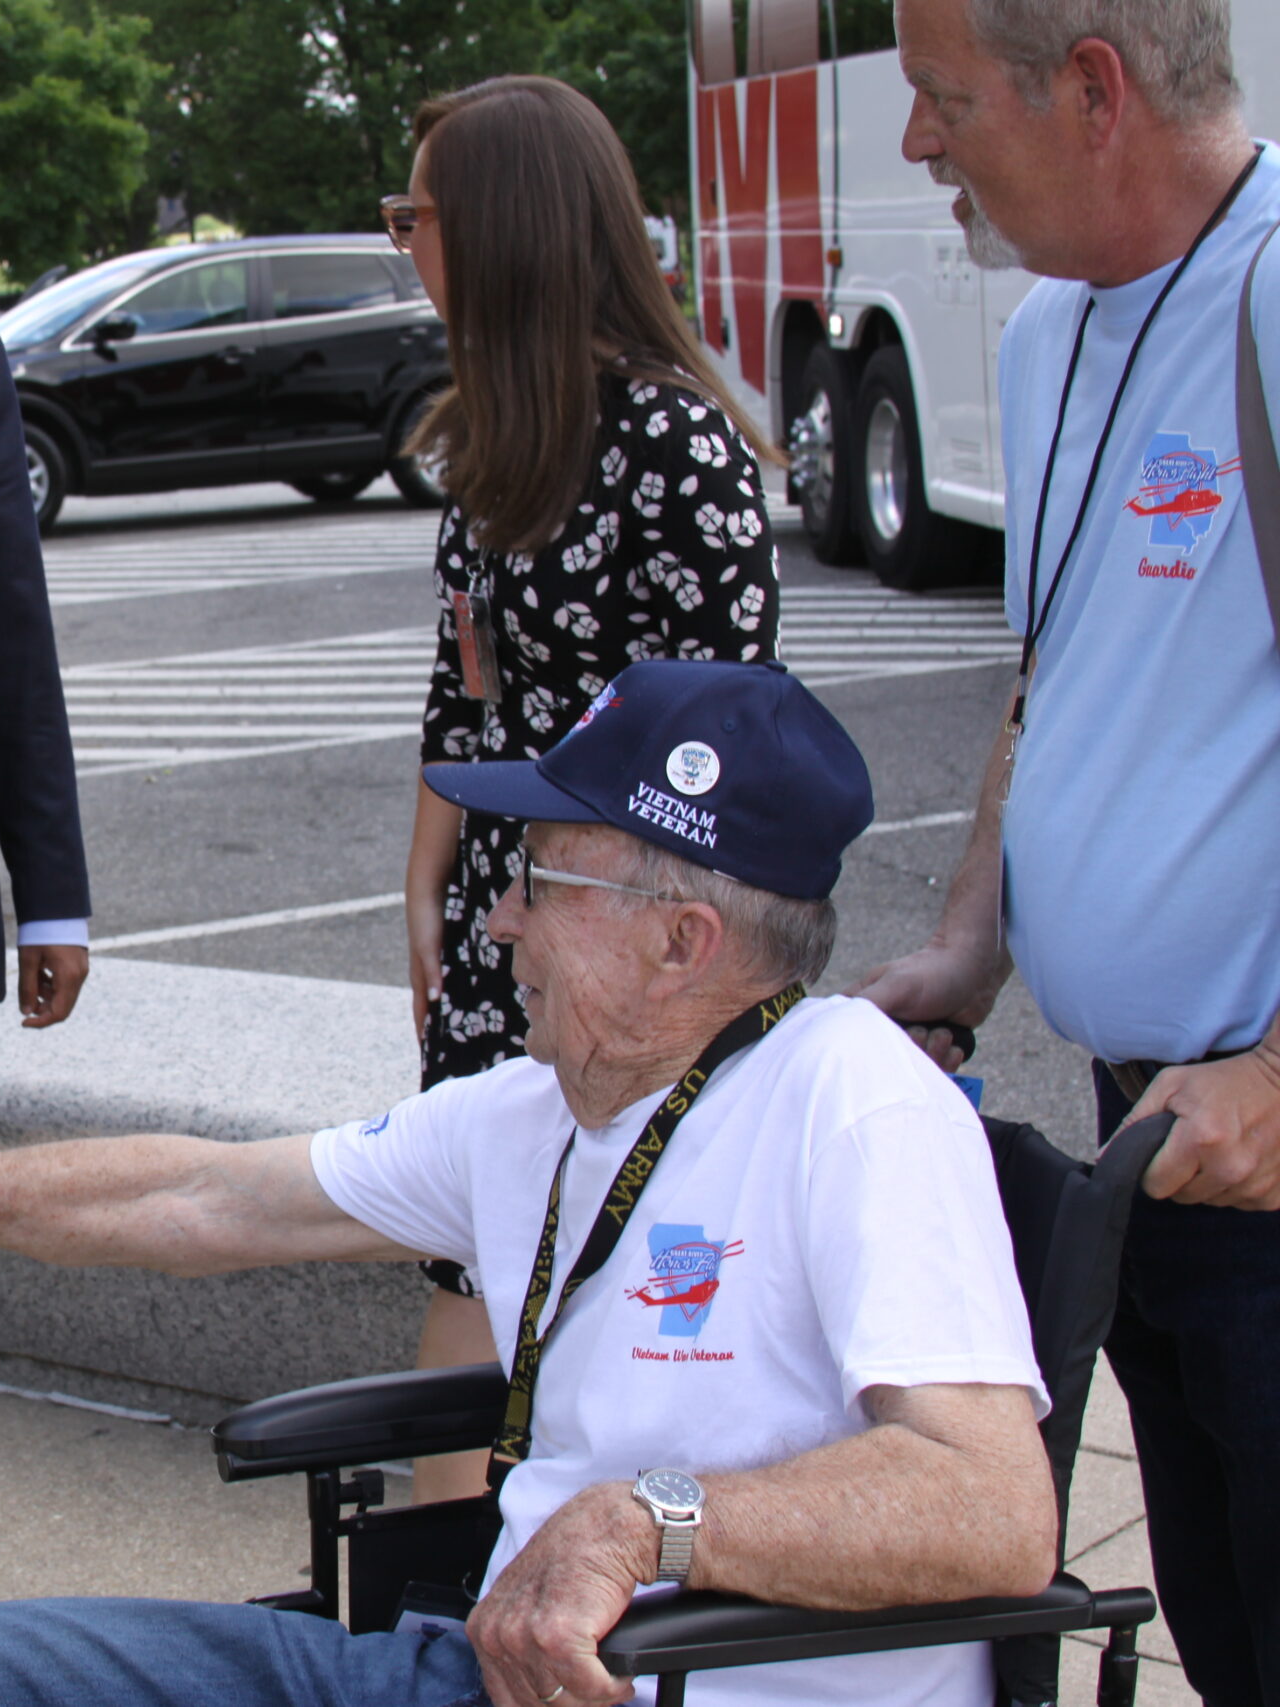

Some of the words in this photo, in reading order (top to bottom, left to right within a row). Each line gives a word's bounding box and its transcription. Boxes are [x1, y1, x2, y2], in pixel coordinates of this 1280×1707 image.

[1138, 556, 1196, 580] Guardia
[627, 794, 718, 849] VETERAN
[638, 781, 716, 830] VIETNAM
[605, 1124, 663, 1226] ARMY
[650, 1249, 692, 1271] Honor
[632, 1346, 670, 1361] Vietnam
[690, 1348, 735, 1362] Veteran
